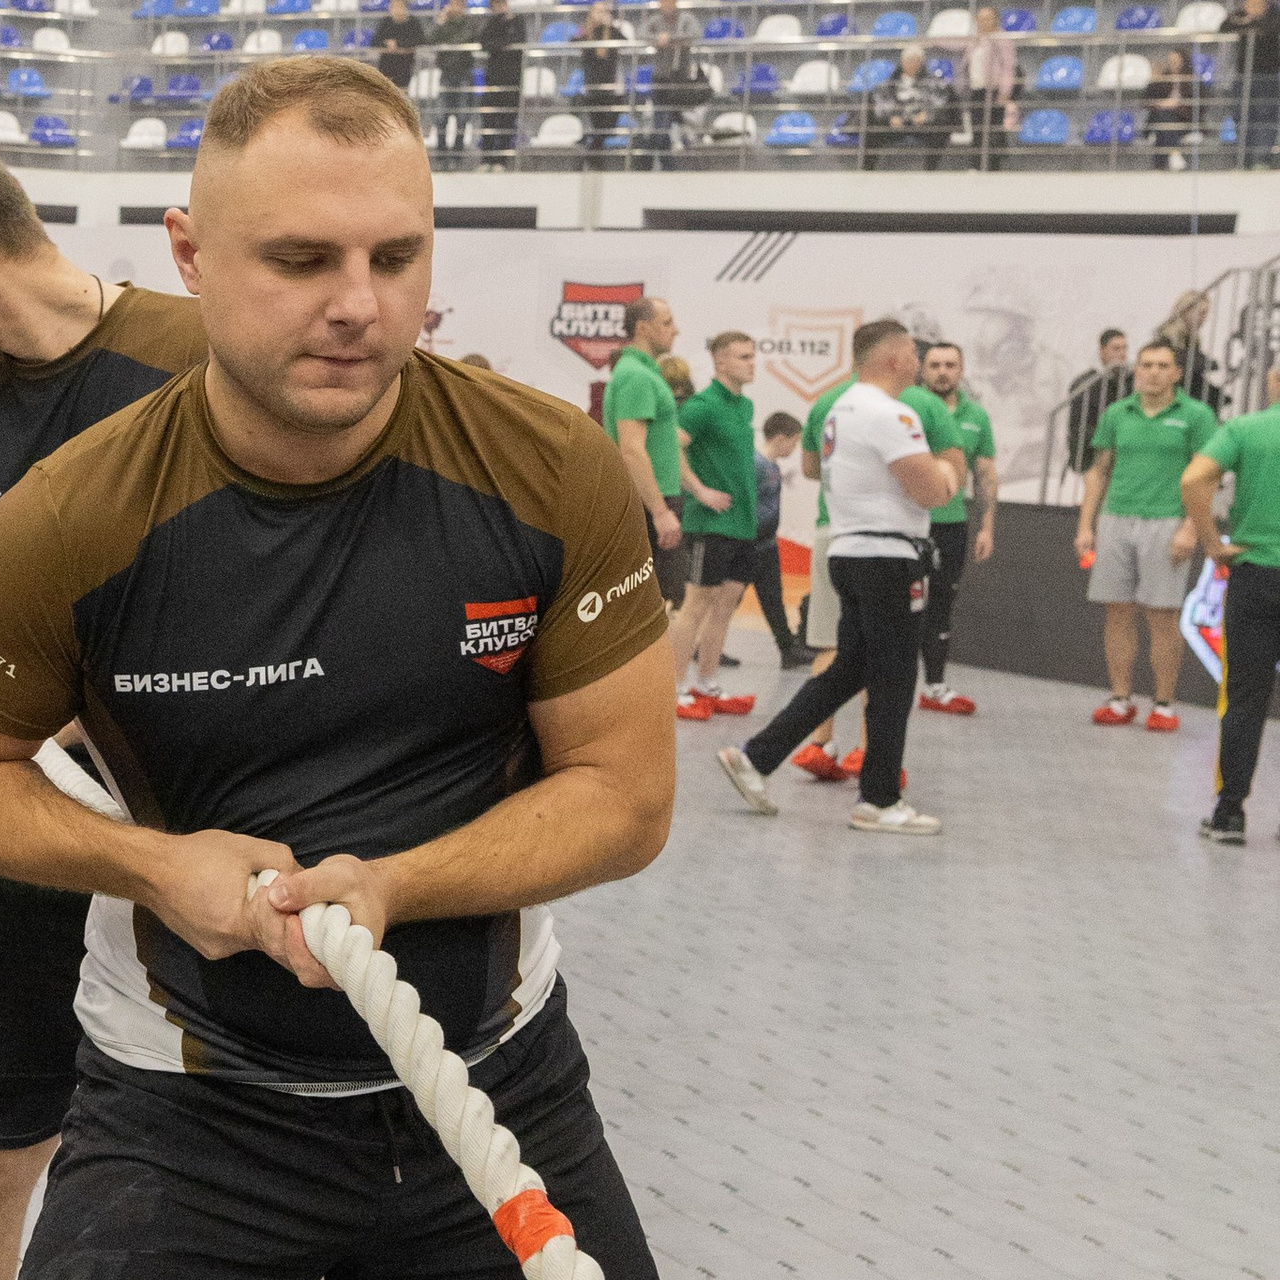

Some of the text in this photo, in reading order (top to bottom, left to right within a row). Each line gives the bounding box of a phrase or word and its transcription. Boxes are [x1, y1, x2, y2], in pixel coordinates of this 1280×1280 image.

[561, 302, 625, 320] БИТВ
[460, 626, 537, 656] КЛУБО
[114, 657, 325, 693] БИЗНЕС-ЛИГА
